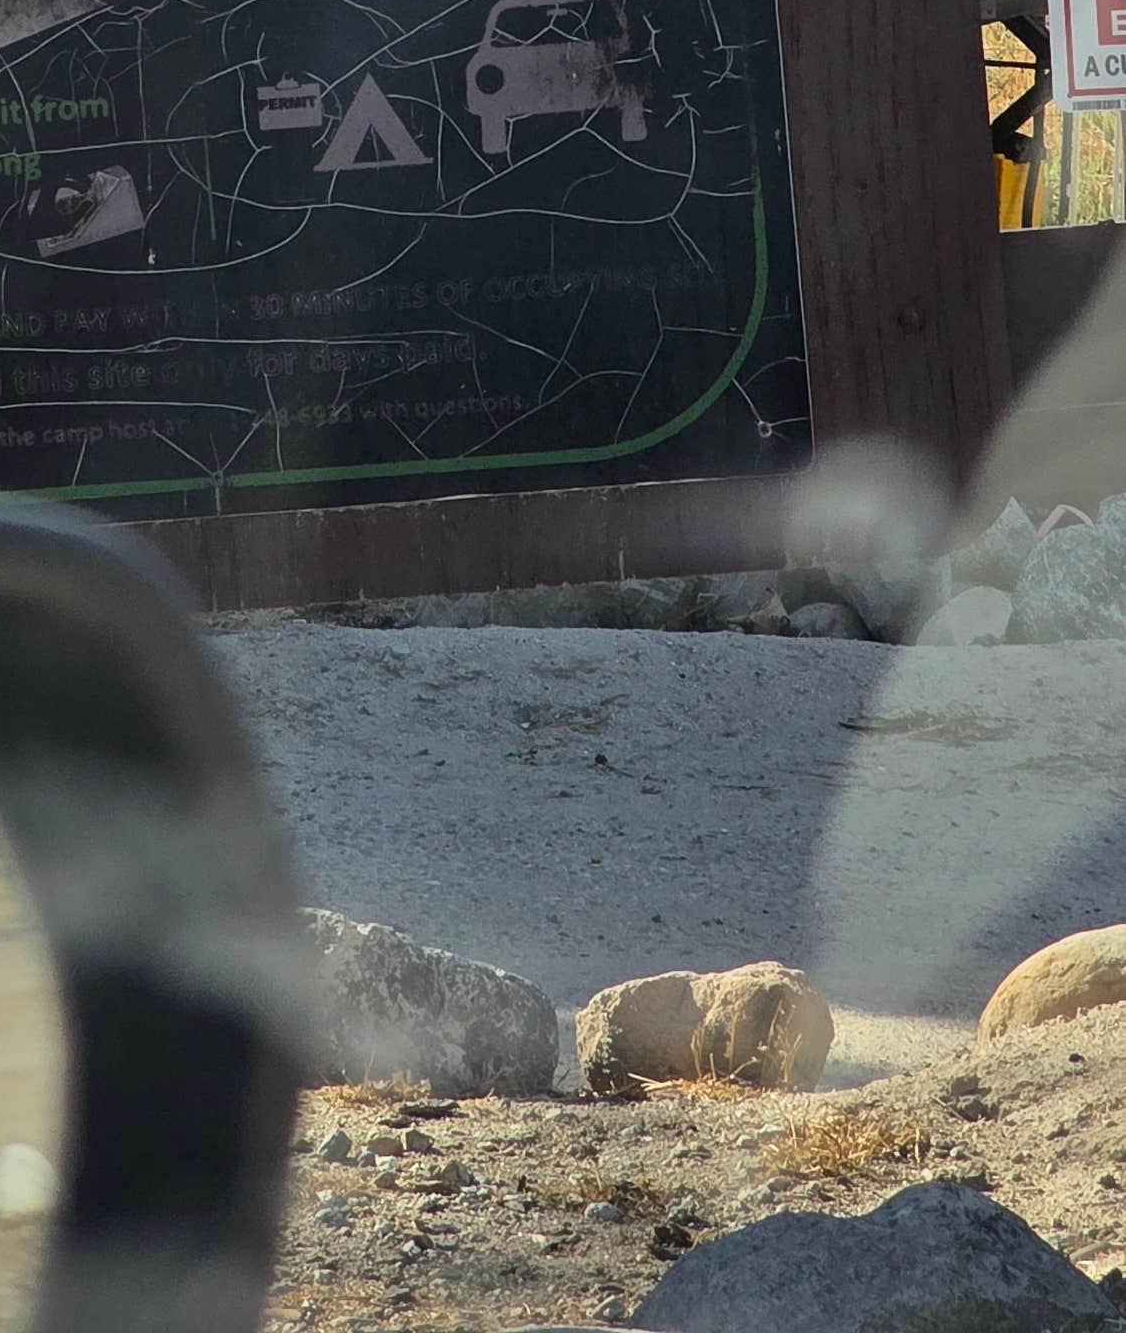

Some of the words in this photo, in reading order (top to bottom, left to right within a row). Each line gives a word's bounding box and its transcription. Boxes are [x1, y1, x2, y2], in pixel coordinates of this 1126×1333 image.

[31, 94, 109, 122] from
[258, 96, 317, 111] PERMIT
[11, 362, 76, 395] this
[87, 357, 152, 390] site
